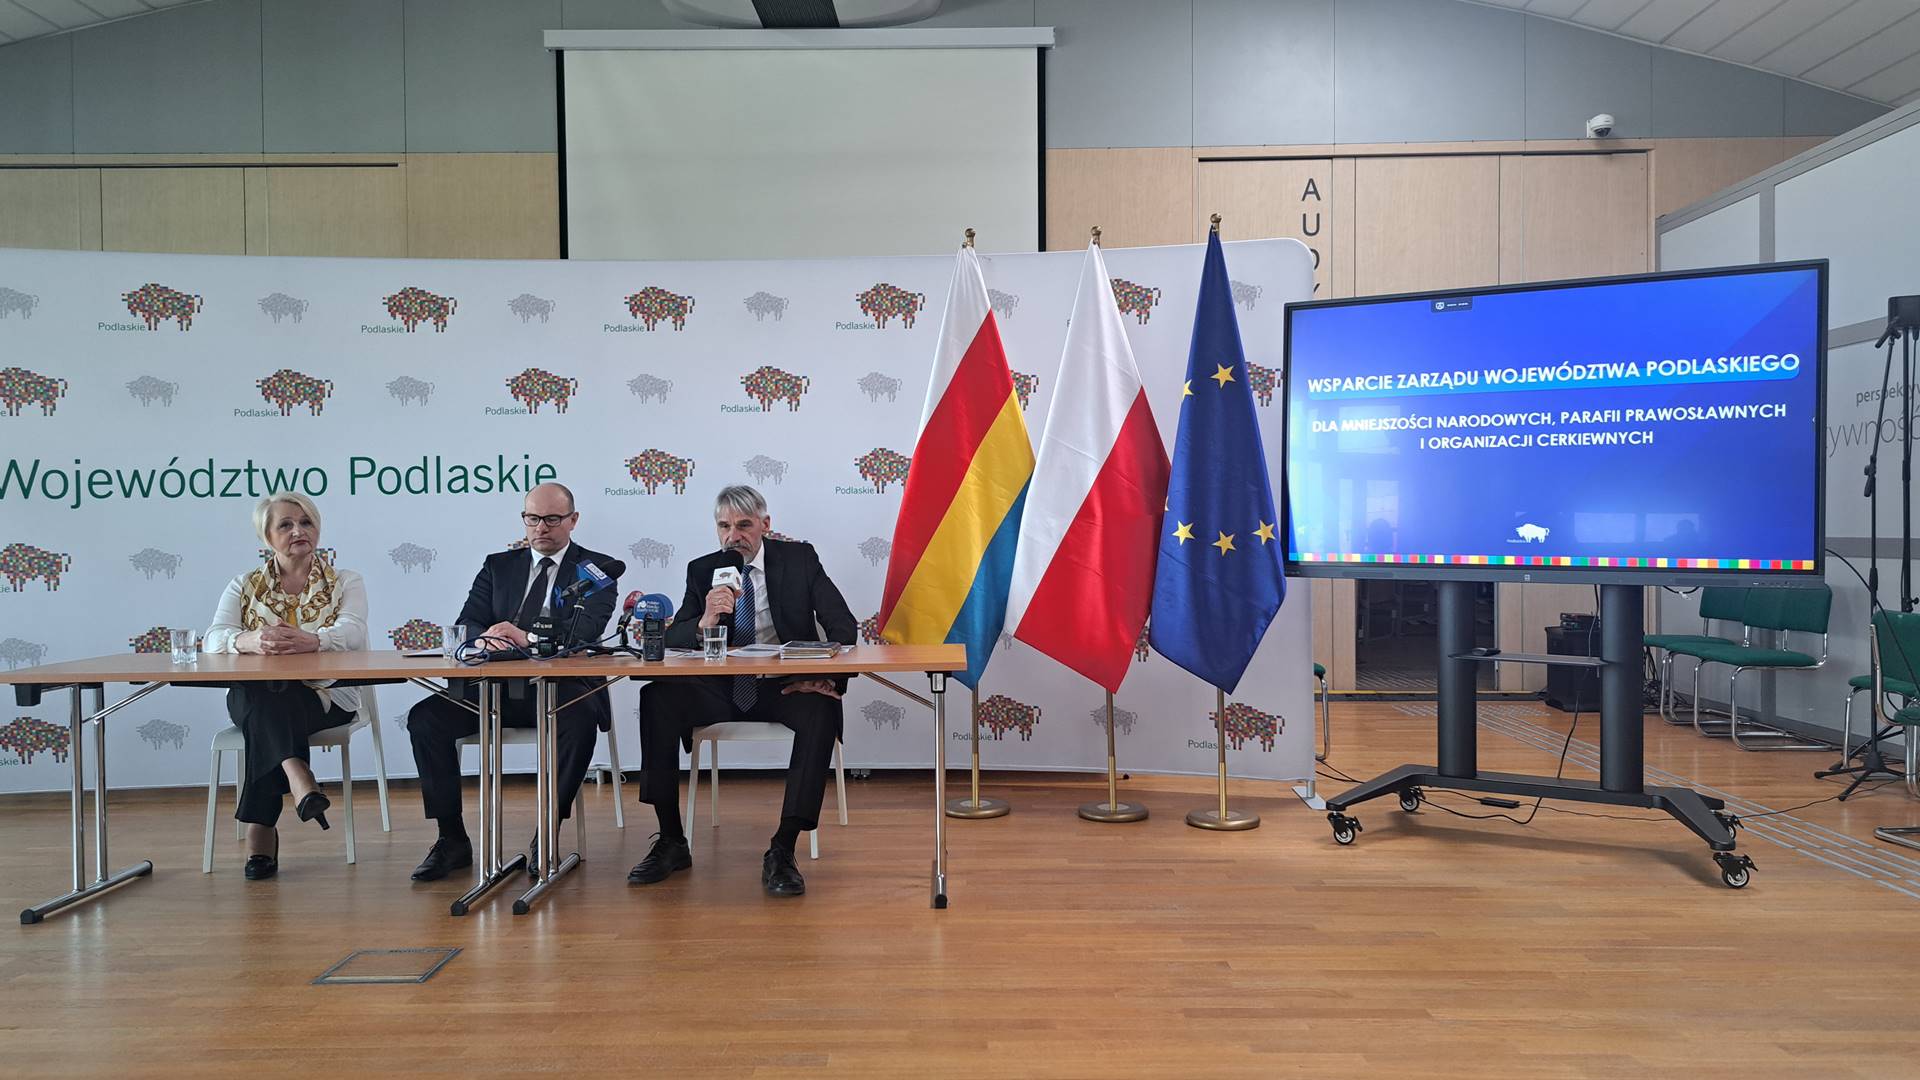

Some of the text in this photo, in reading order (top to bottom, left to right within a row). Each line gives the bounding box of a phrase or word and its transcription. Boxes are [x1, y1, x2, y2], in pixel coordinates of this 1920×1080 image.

[98, 322, 146, 332] Podlaskie
[360, 324, 405, 334] Podlaskie
[603, 323, 645, 332] Podlaskie
[835, 321, 876, 330] Podlaskie
[1307, 353, 1800, 393] WSPARCIE ZARZĄDU WOJEWÓDZTWA PODLASKIEGO
[234, 408, 280, 418] Podlaskie
[484, 406, 527, 416] Podlaskie
[720, 403, 761, 413] Podlaskie
[1312, 403, 1787, 433] DLA MNIEJSZOŚCI NARODOWYCH, PARAFII PRAWOSŁAWNYCH
[1420, 430, 1654, 449] I ORGANIZACJI CERKIEWNYCH
[0, 453, 558, 510] Województwo Podlaskie
[604, 487, 646, 496] Podlaskie
[834, 485, 875, 494] Podlaskie
[952, 731, 993, 741] Podlkie
[1187, 738, 1232, 750] Podlase
